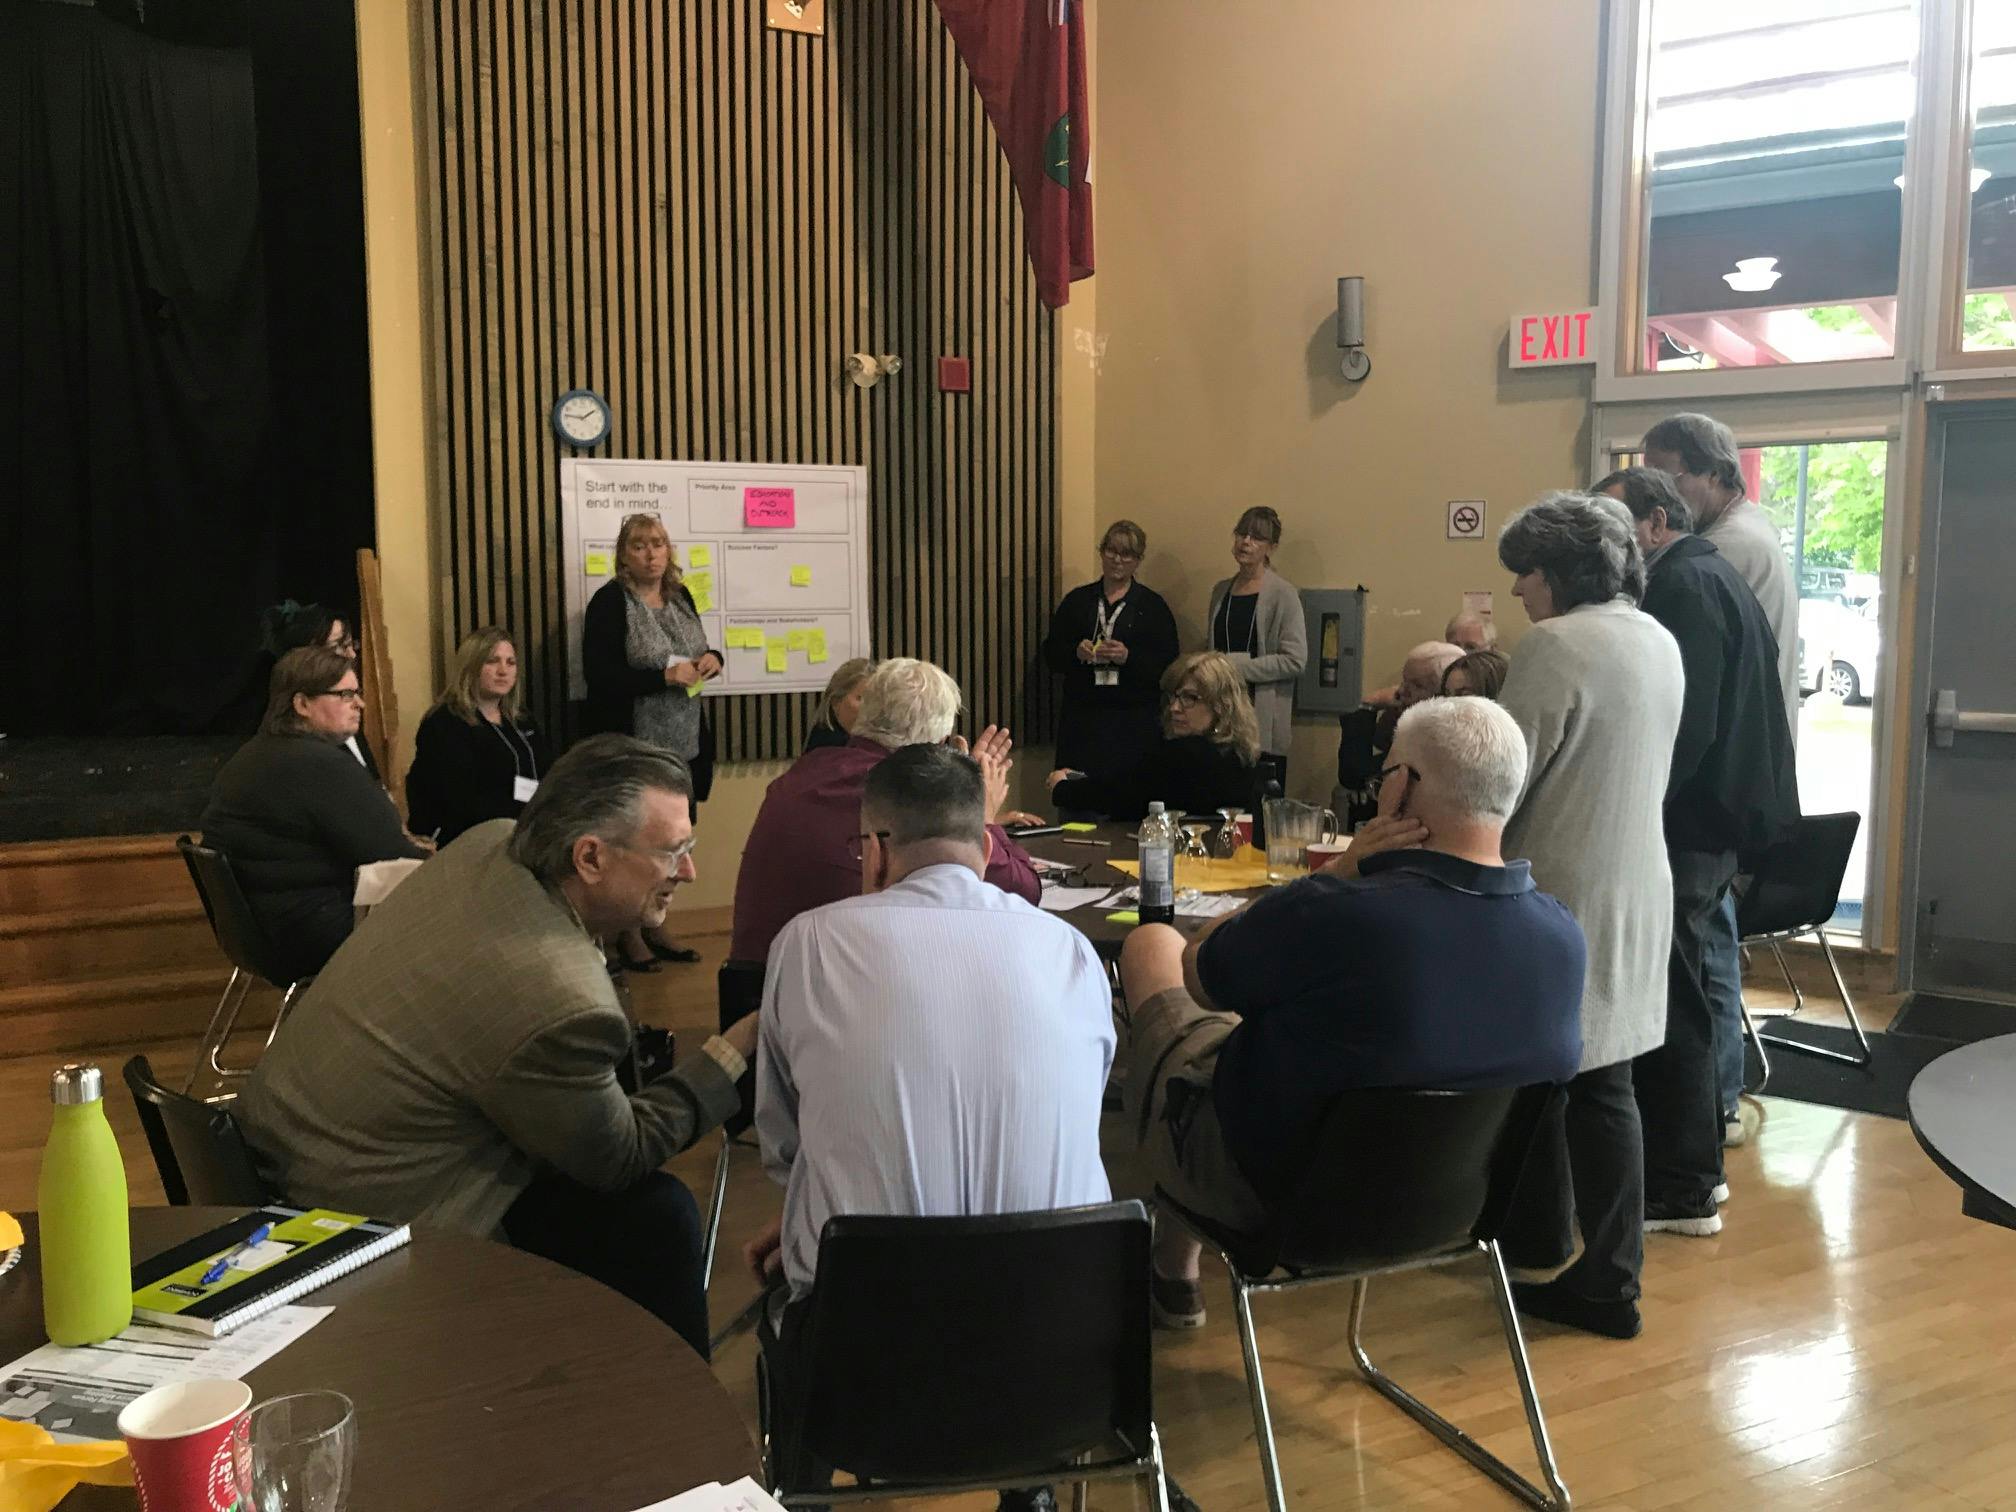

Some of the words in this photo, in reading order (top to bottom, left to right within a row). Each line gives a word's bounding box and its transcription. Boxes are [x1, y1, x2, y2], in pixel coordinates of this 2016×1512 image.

[1521, 313, 1591, 361] EXIT
[585, 480, 615, 493] Start
[619, 481, 645, 493] with
[648, 481, 668, 494] the
[586, 498, 610, 509] end
[614, 498, 625, 509] in
